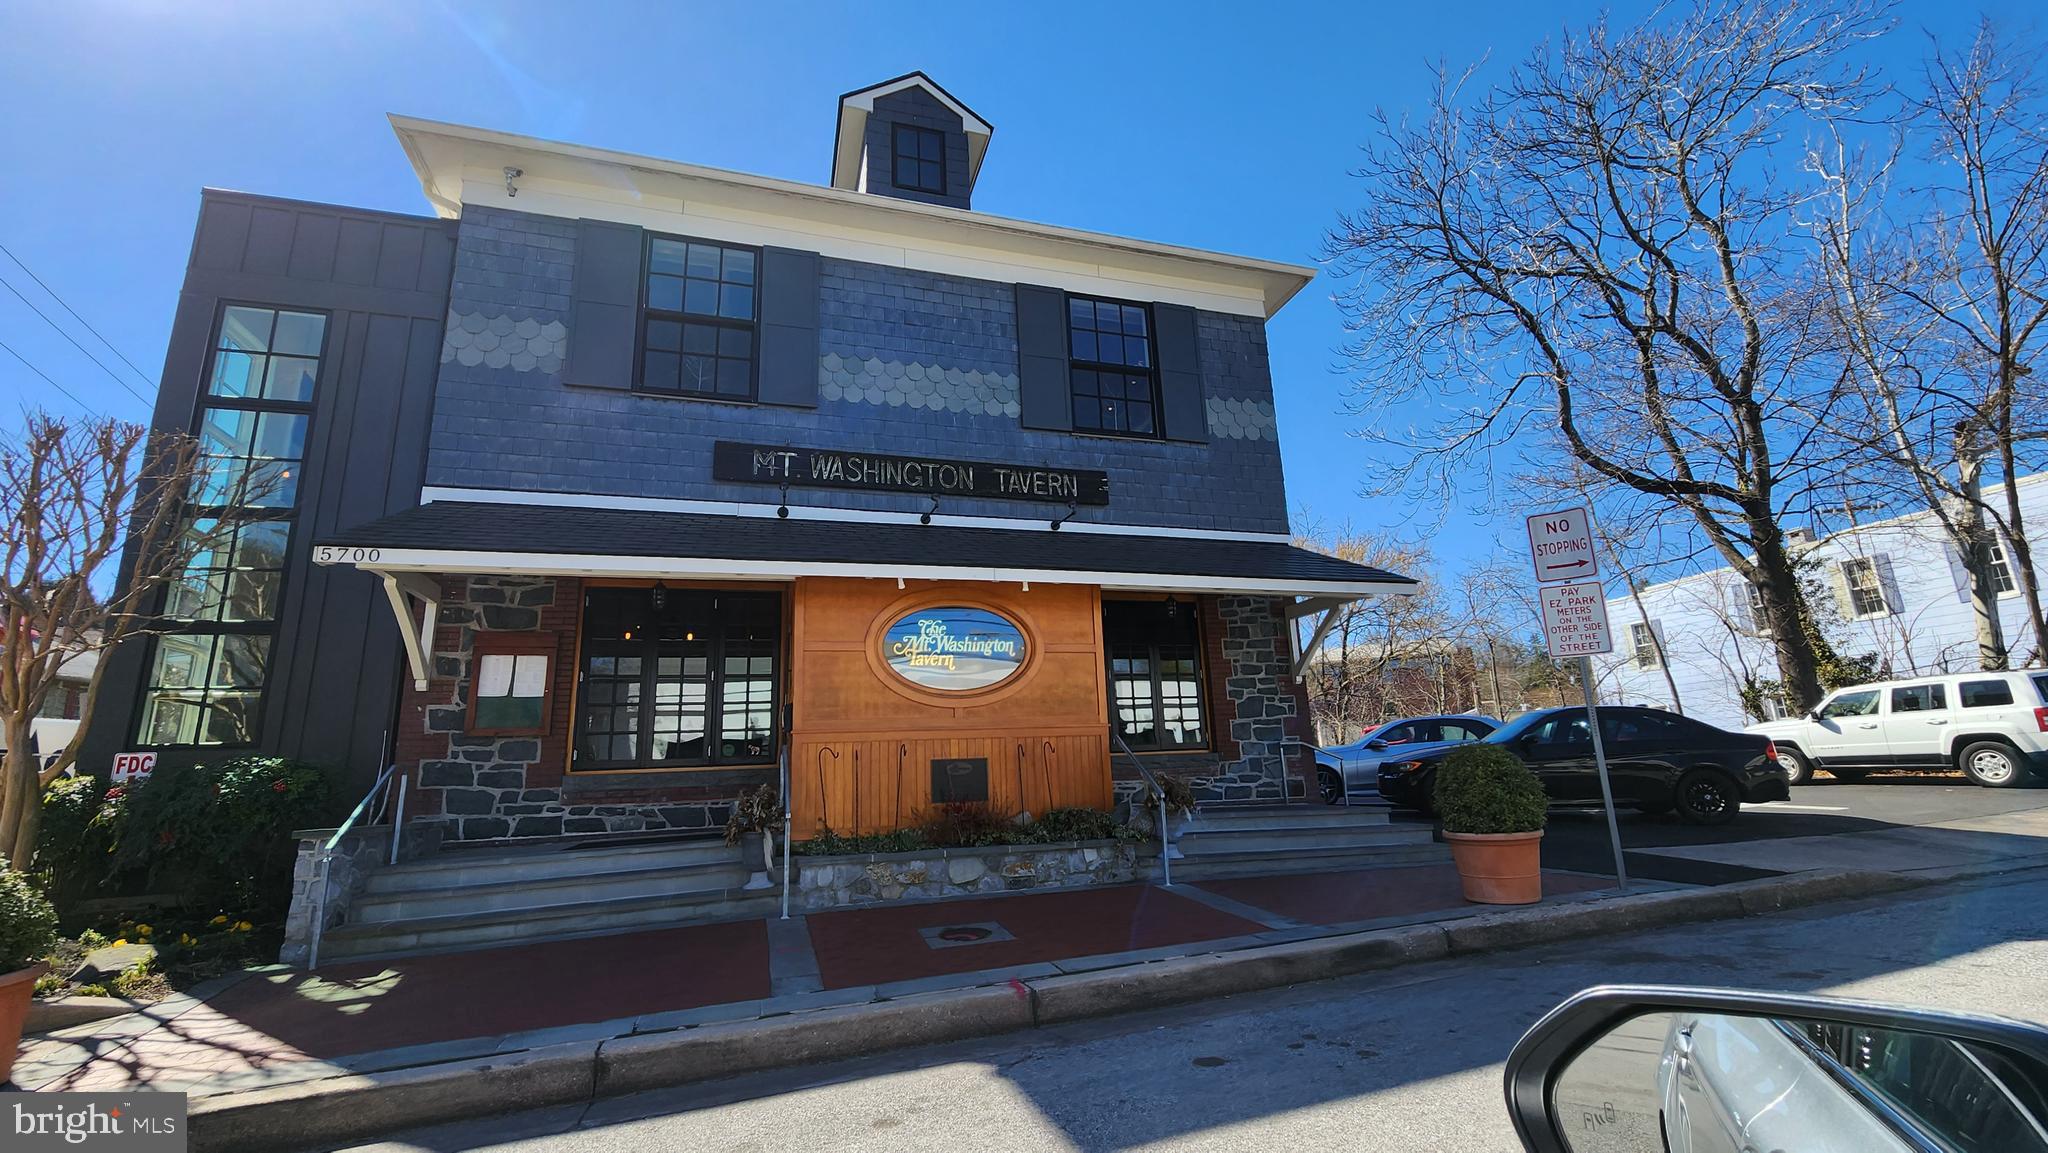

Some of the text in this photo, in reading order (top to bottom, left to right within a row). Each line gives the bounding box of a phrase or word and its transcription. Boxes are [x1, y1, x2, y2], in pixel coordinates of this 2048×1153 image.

[753, 449, 1078, 498] MT. WASHINGTON TAVERN
[1545, 519, 1570, 535] NO
[320, 547, 380, 562] 5700
[1536, 537, 1587, 557] STOPPING
[1560, 587, 1580, 597] PAY
[1550, 596, 1596, 608] EZ PARK
[1556, 606, 1592, 617] METERS
[1559, 615, 1593, 625] ON THE
[918, 619, 947, 638] The
[1551, 622, 1602, 634] OTHER SIDE
[1560, 632, 1599, 643] OF THE
[893, 635, 1016, 657] Mt. Washington
[1559, 641, 1602, 653] STREET
[904, 649, 956, 671] Tavern
[115, 755, 153, 774] FDC
